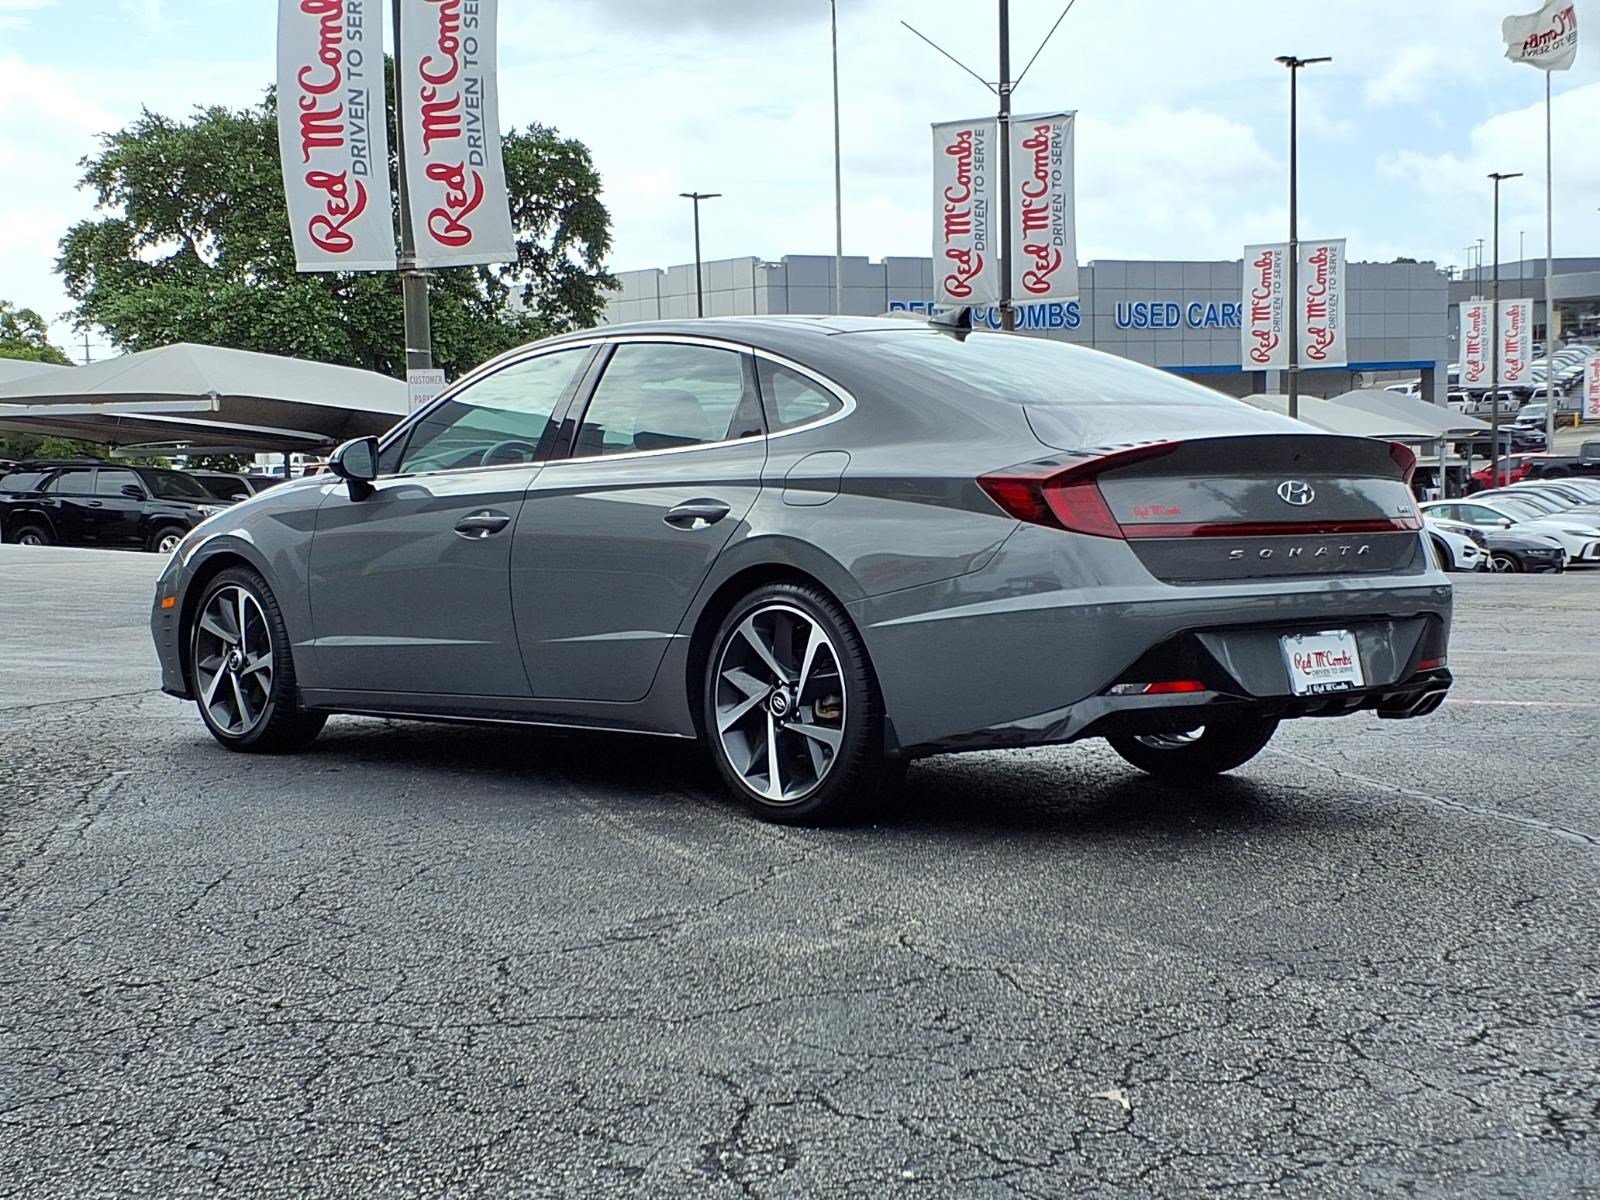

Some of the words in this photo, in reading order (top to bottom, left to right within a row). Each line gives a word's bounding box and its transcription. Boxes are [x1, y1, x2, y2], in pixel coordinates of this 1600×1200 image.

[347, 49, 363, 81] TO
[463, 37, 479, 69] TO
[419, 0, 461, 156] McCom
[349, 89, 368, 176] DRIVEN
[465, 77, 484, 167] DRIVEN
[974, 129, 985, 171] SERVE
[1052, 124, 1063, 165] SERVE
[944, 130, 972, 245] McCombs
[974, 175, 985, 195] TO
[1022, 124, 1050, 240] McCombs
[1051, 169, 1062, 190] TO
[305, 169, 367, 253] Red
[425, 160, 484, 247] Red
[1051, 194, 1064, 247] DRIVEN
[974, 199, 985, 251] DRIVEN
[944, 248, 983, 297] Red
[1022, 243, 1062, 294] Red
[1274, 250, 1282, 279] SERVE
[1329, 246, 1337, 276] SERVE
[1251, 250, 1273, 327] McCombs
[1273, 281, 1281, 296] TO
[1306, 247, 1328, 324] McCombs
[1329, 278, 1337, 292] TO
[1115, 302, 1181, 328] USED
[1273, 298, 1281, 332] DRIVEN
[1329, 294, 1337, 329] DRIVEN
[1250, 329, 1279, 363] Red
[1306, 326, 1335, 360] Red
[1466, 306, 1480, 357] McCombs
[1504, 305, 1519, 357] McCombs
[410, 376, 442, 385] CUSTOMER
[1465, 360, 1485, 382] Red
[1504, 358, 1524, 381] Red
[1228, 545, 1369, 559] SONATA
[1294, 652, 1312, 675] Red
[1312, 650, 1352, 668] McCombs
